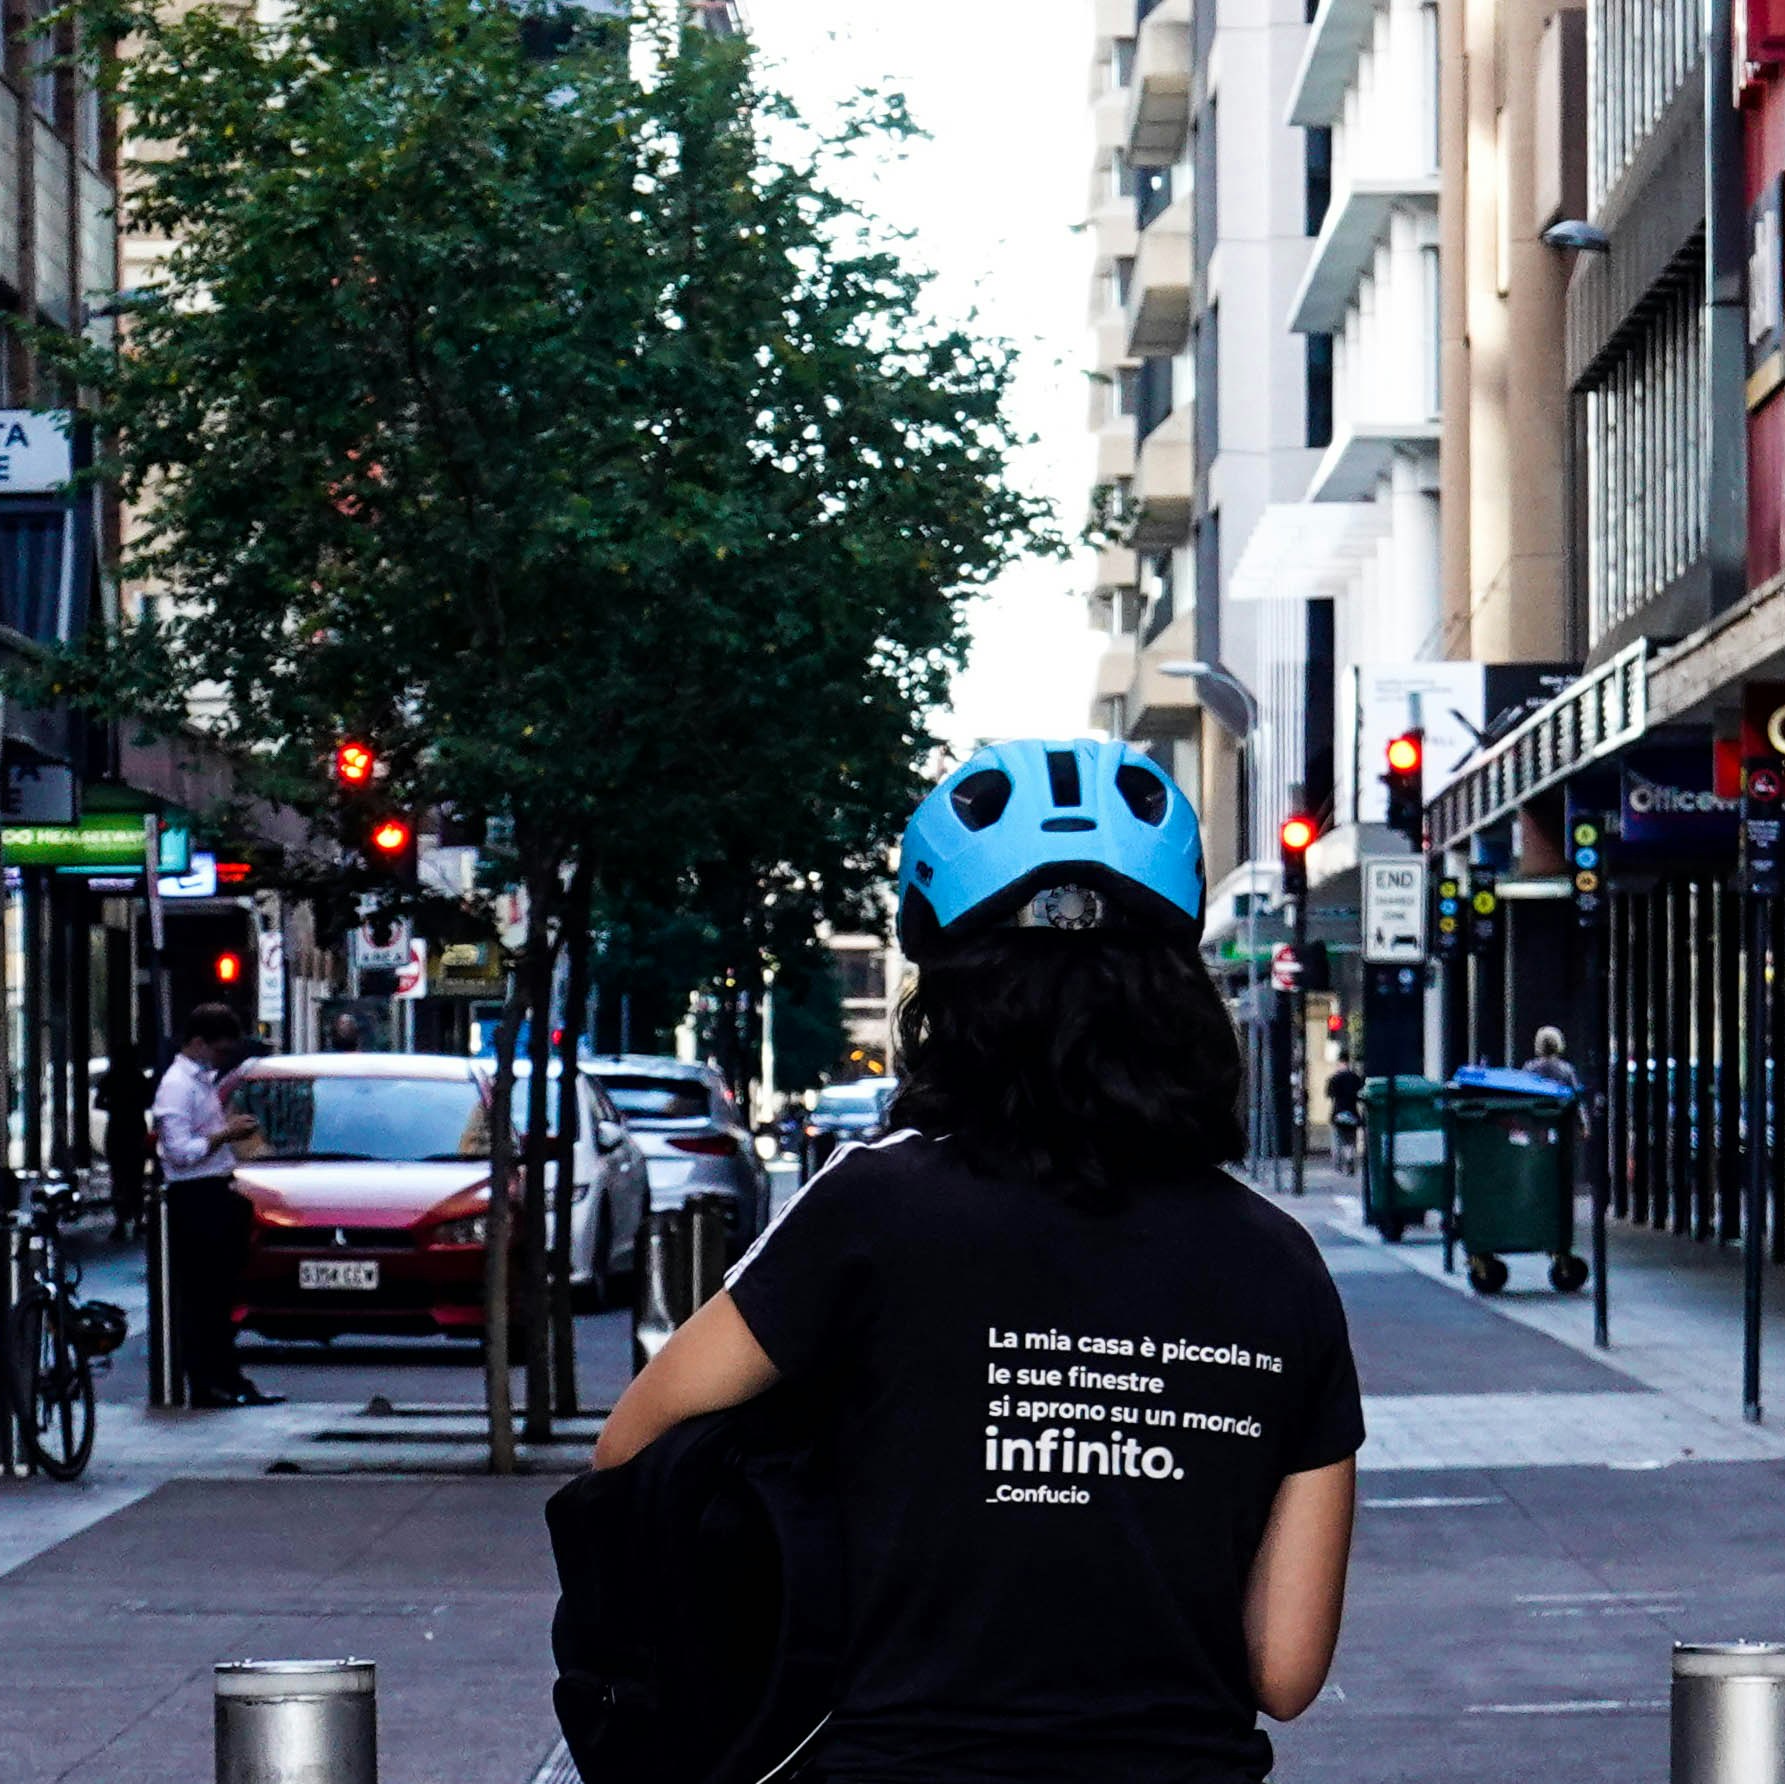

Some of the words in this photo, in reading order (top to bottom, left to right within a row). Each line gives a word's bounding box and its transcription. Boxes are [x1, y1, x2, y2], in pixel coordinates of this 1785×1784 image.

[1375, 870, 1414, 889] END
[988, 1328, 1018, 1349] La
[1024, 1329, 1071, 1351] mia
[1077, 1336, 1133, 1356] casa
[1140, 1337, 1155, 1358] è
[1162, 1340, 1250, 1368] piccola
[1256, 1351, 1283, 1373] ma
[988, 1364, 1011, 1384] le
[1017, 1368, 1062, 1387] sue
[1068, 1366, 1165, 1393] finestre
[988, 1396, 1010, 1417] si
[1017, 1400, 1106, 1423] aprono
[1110, 1404, 1139, 1423] su
[1145, 1409, 1176, 1426] un
[1183, 1411, 1262, 1438] mondo
[985, 1426, 1185, 1480] infinito.
